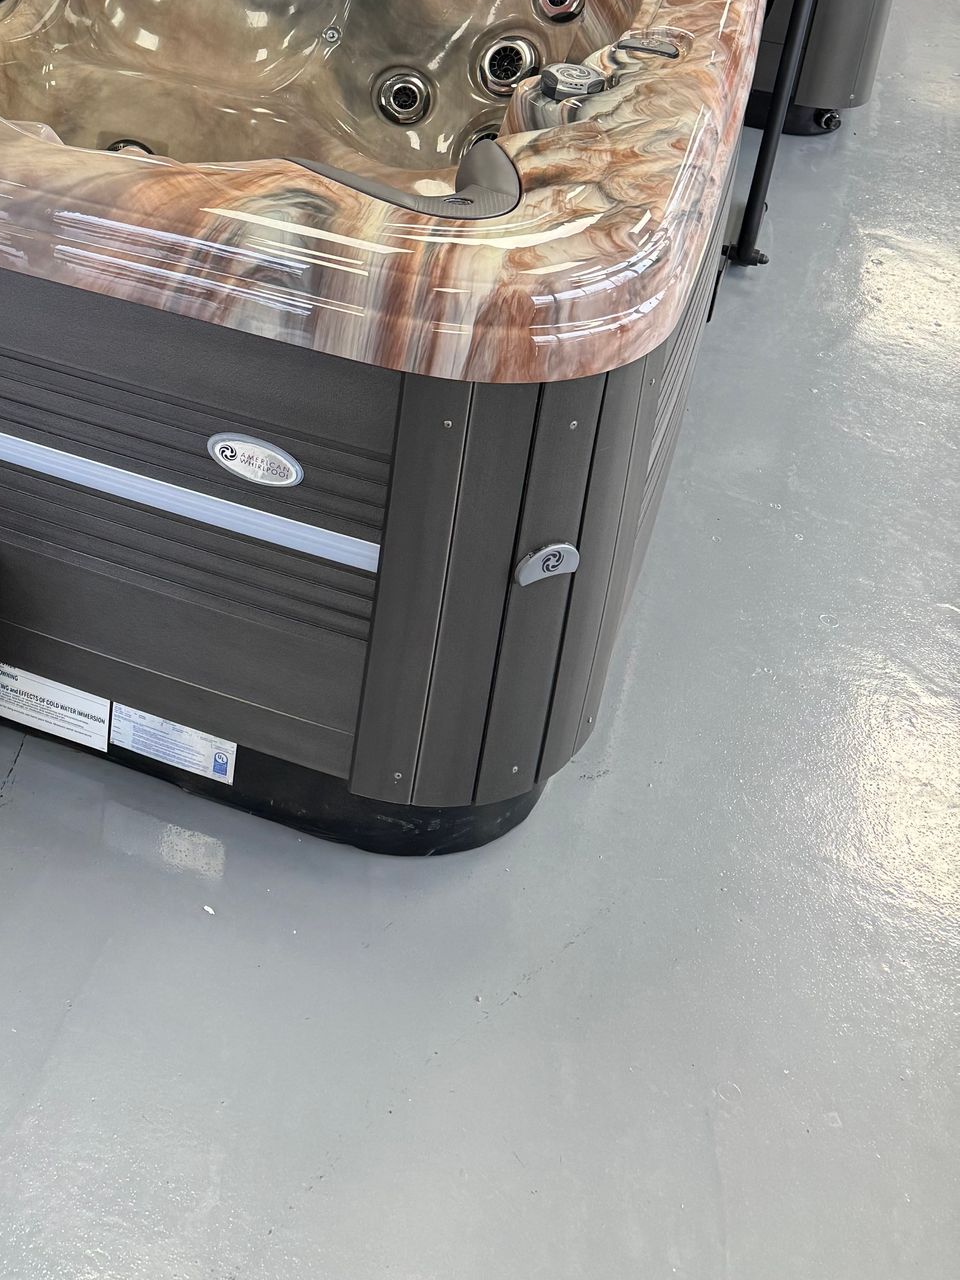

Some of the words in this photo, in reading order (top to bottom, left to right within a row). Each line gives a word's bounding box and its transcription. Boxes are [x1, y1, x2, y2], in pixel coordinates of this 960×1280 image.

[240, 458, 289, 479] WHIRLPOOL
[241, 452, 290, 472] AMERICAN
[18, 689, 39, 702] EFFECTS
[38, 697, 47, 705] OF
[46, 699, 60, 709] COLD
[60, 704, 78, 714] WATER
[77, 710, 106, 725] IMMERSION
